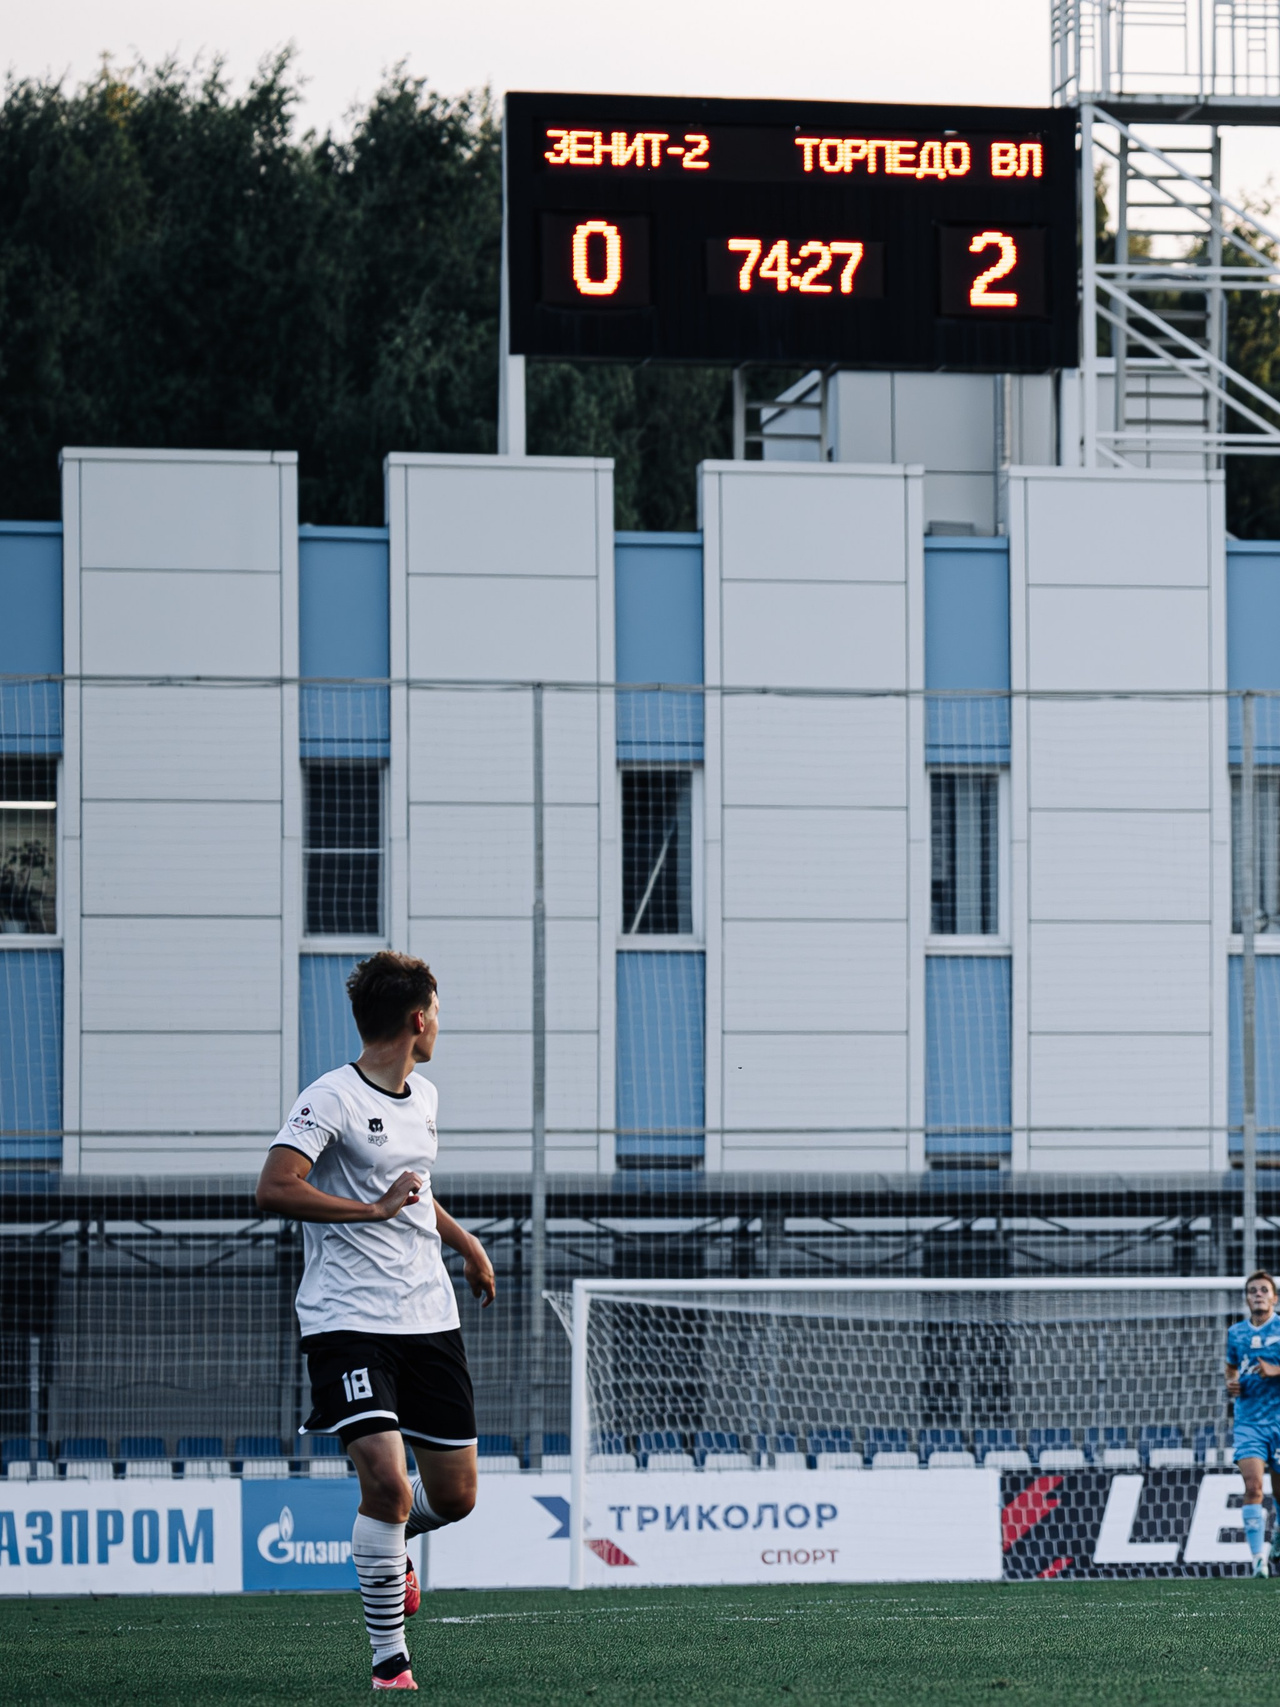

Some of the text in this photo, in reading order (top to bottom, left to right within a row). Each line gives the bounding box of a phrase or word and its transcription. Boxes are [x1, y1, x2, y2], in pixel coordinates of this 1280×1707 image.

[544, 129, 710, 169] ЗЕНИТ-2
[795, 137, 1043, 180] ТОРПЕДО ВЛ
[572, 219, 622, 296] 0
[728, 237, 864, 294] 74:27
[969, 230, 1018, 307] 2
[342, 1367, 373, 1403] 18
[608, 1503, 838, 1532] ТРИКОЛОР
[761, 1549, 839, 1565] СПОРТ
